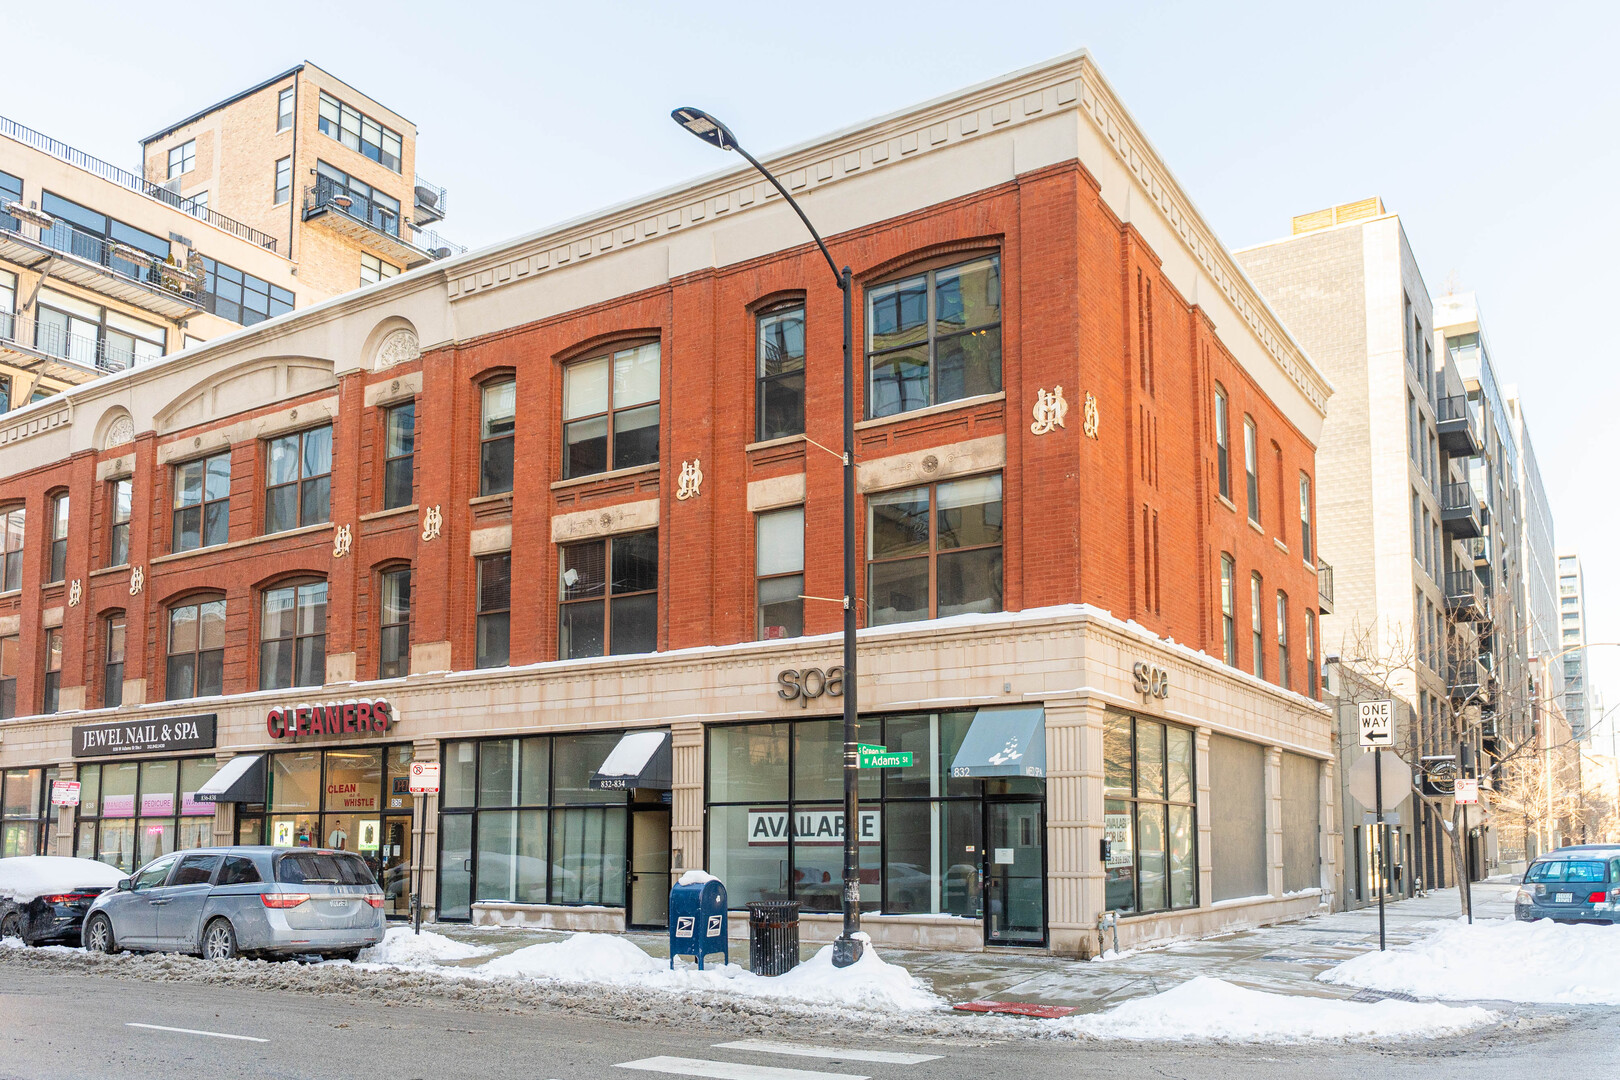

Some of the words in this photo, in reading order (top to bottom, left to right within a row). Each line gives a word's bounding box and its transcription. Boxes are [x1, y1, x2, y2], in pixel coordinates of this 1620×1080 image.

[777, 665, 844, 708] spa
[1362, 704, 1388, 716] ONE
[266, 701, 390, 739] CLEANERS
[1362, 716, 1388, 728] WAY
[82, 728, 123, 751] JEWEL
[126, 725, 158, 744] NAIL
[161, 723, 172, 742] &
[174, 721, 199, 741] SPA
[862, 746, 879, 755] Green
[871, 755, 900, 766] Adams
[953, 767, 970, 778] 832
[327, 783, 356, 794] CLEAN
[394, 779, 409, 792] OPE
[600, 780, 626, 789] 832-834
[144, 799, 171, 808] PEDICURE
[343, 797, 375, 807] WHISTLE
[753, 815, 874, 837] AVAILABE
